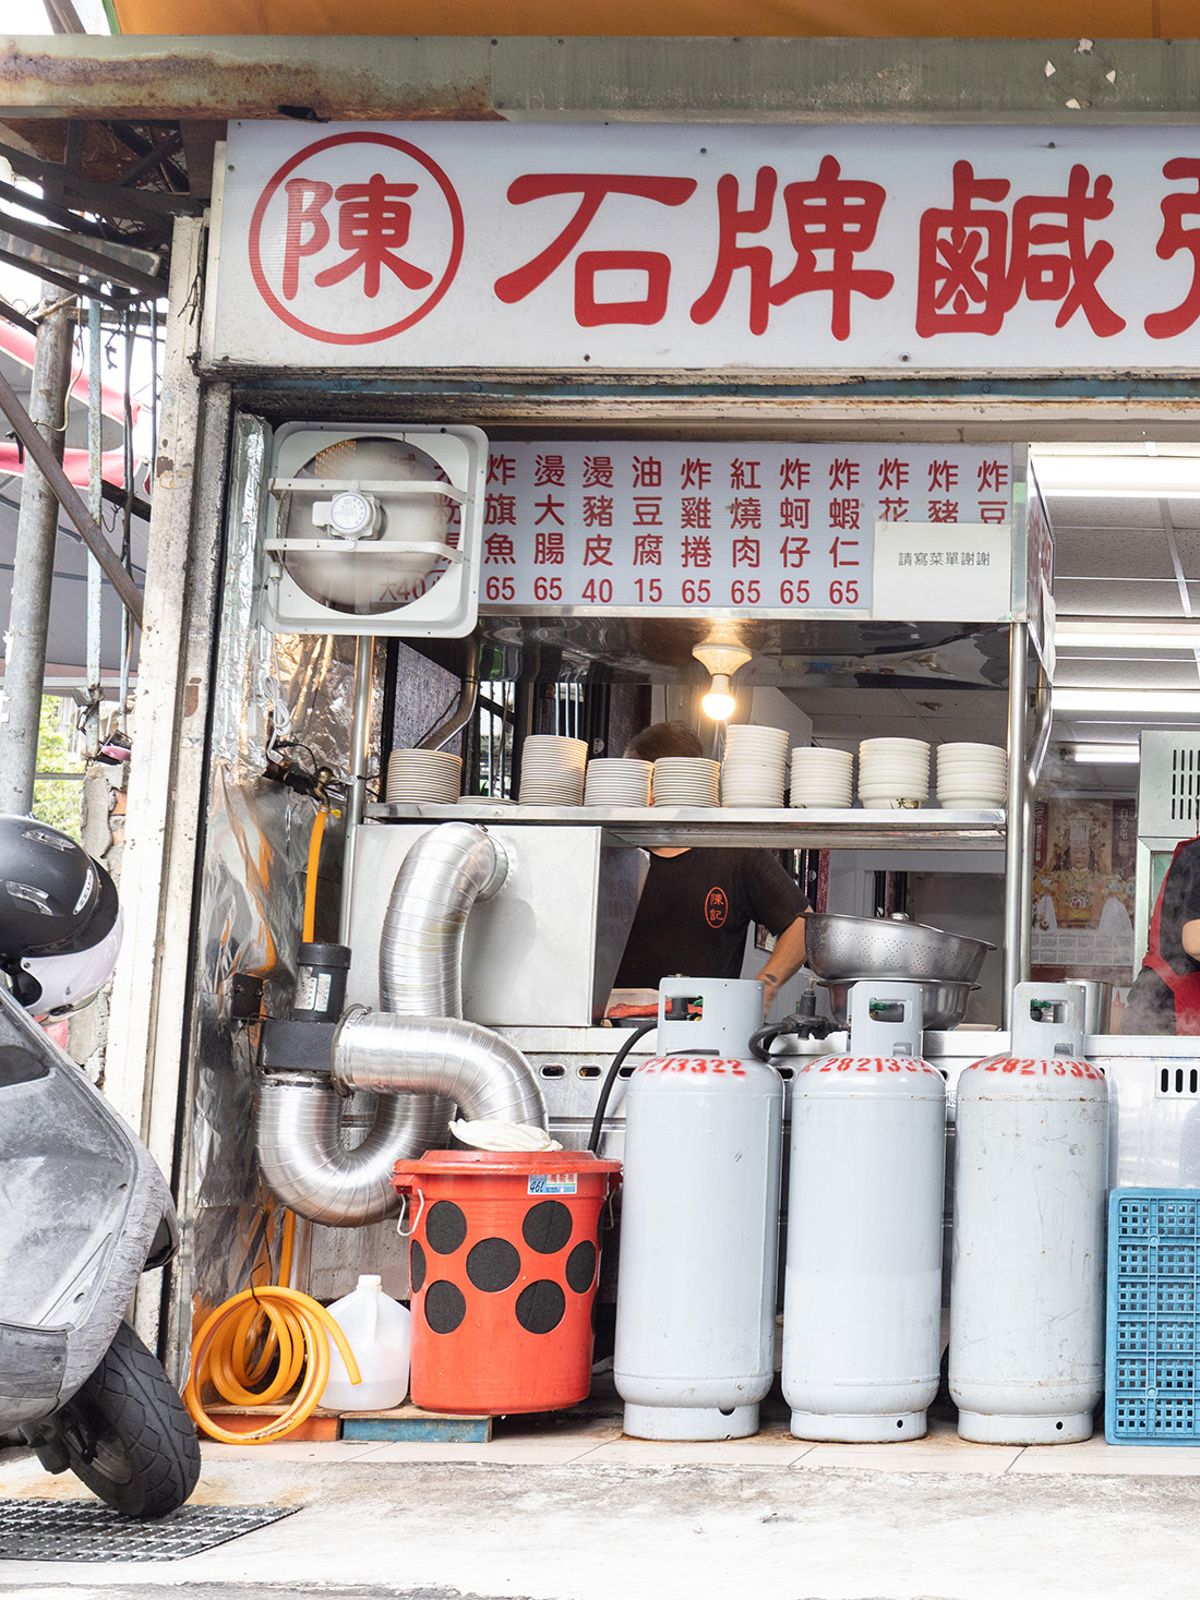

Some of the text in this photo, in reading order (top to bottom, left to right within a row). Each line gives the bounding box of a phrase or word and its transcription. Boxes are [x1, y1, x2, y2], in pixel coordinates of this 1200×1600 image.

[284, 173, 433, 300] 陳
[484, 454, 516, 601] 炸旗魚 65
[534, 454, 565, 601] 燙大腸 65
[581, 455, 614, 603] 燙豬皮 40
[632, 455, 663, 603] 油豆腐 15
[680, 457, 712, 604] 炸雞捲 65
[730, 457, 761, 604] 紅燒肉 65
[780, 458, 810, 604] 炸蚵仔 65
[829, 458, 860, 604] 炸蝦仁 65
[899, 551, 991, 567] 請寫菜單謝謝
